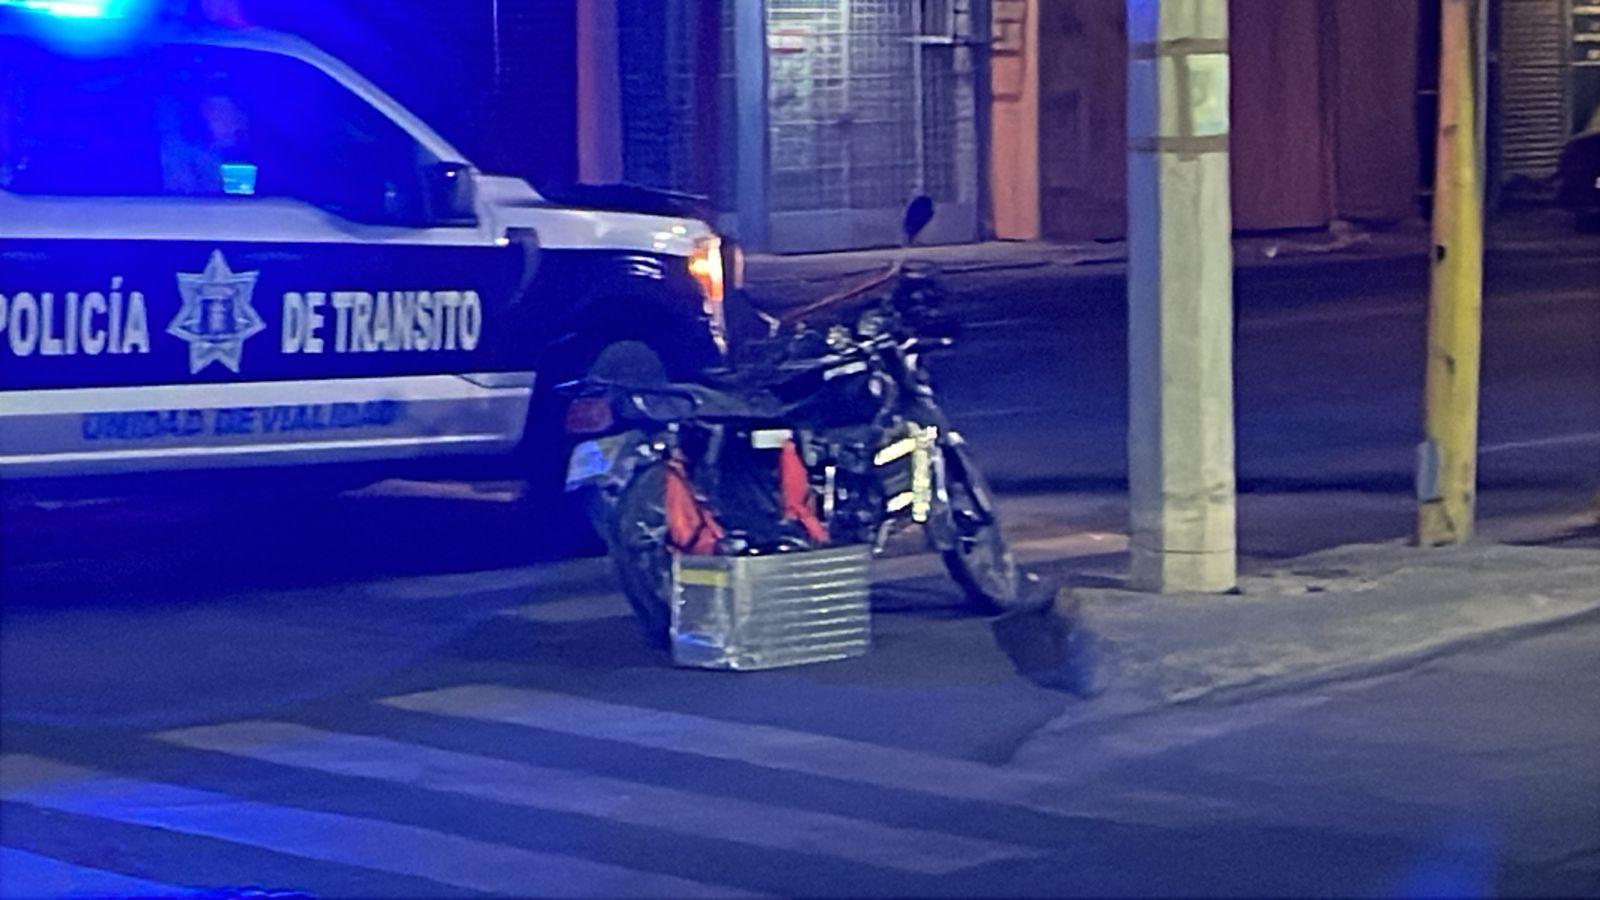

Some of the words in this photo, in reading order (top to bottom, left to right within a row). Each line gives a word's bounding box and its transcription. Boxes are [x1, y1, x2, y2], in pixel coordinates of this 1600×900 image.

[0, 276, 150, 357] OLICÍA
[281, 291, 326, 353] DE
[331, 290, 482, 351] TRANSITO
